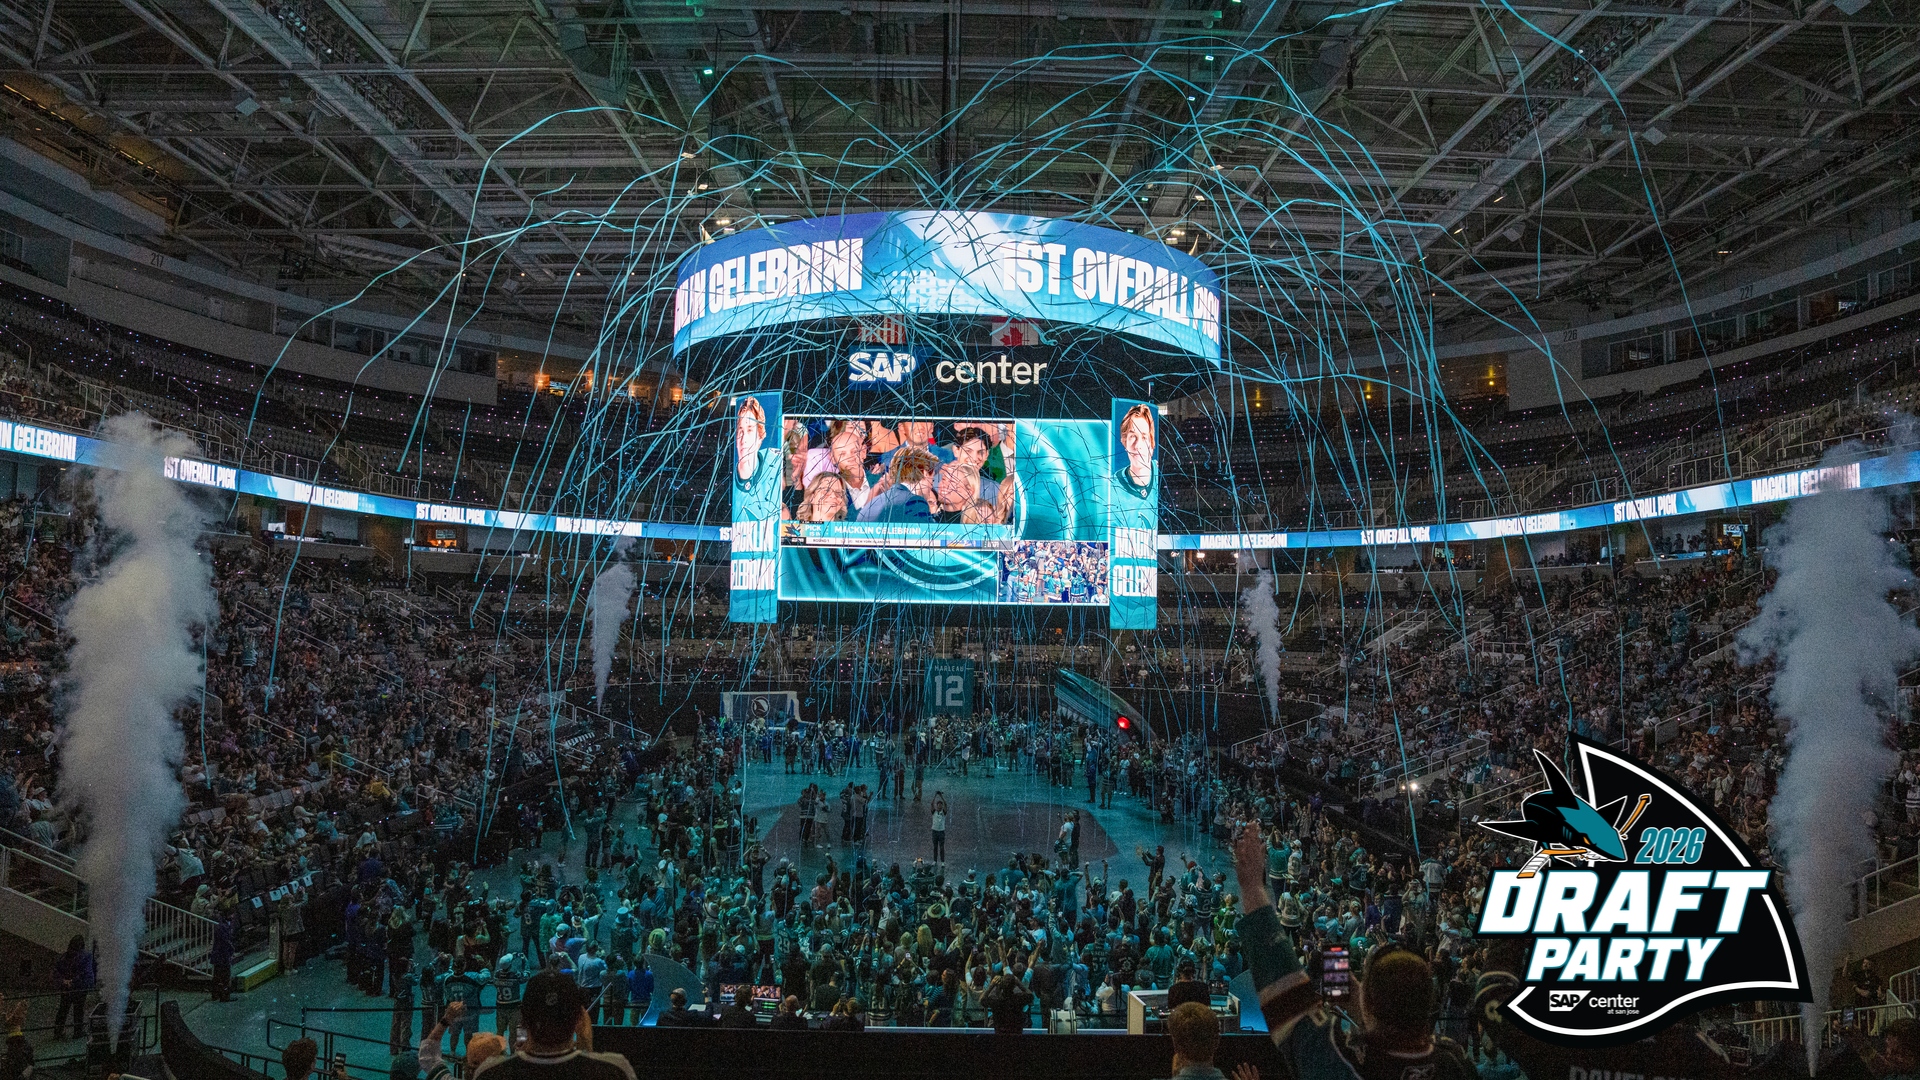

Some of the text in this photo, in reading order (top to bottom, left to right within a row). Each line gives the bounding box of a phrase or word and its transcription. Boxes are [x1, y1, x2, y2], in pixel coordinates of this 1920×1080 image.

[709, 238, 863, 314] CELEBRINI
[1000, 239, 1066, 295] 1ST
[1072, 248, 1190, 327] OVERALL
[849, 352, 1048, 384] SAP center
[14, 424, 77, 461] CELEBRINI
[164, 456, 237, 490] 1ST OVERALL PICK
[1752, 473, 1799, 502] MACKLIN
[416, 503, 485, 524] 1ST OVERALL PICK
[1613, 493, 1677, 522] 1ST OVERALL PICK
[834, 525, 874, 534] MACKLIN
[875, 525, 920, 536] CELEBRINI
[934, 674, 964, 707] 12
